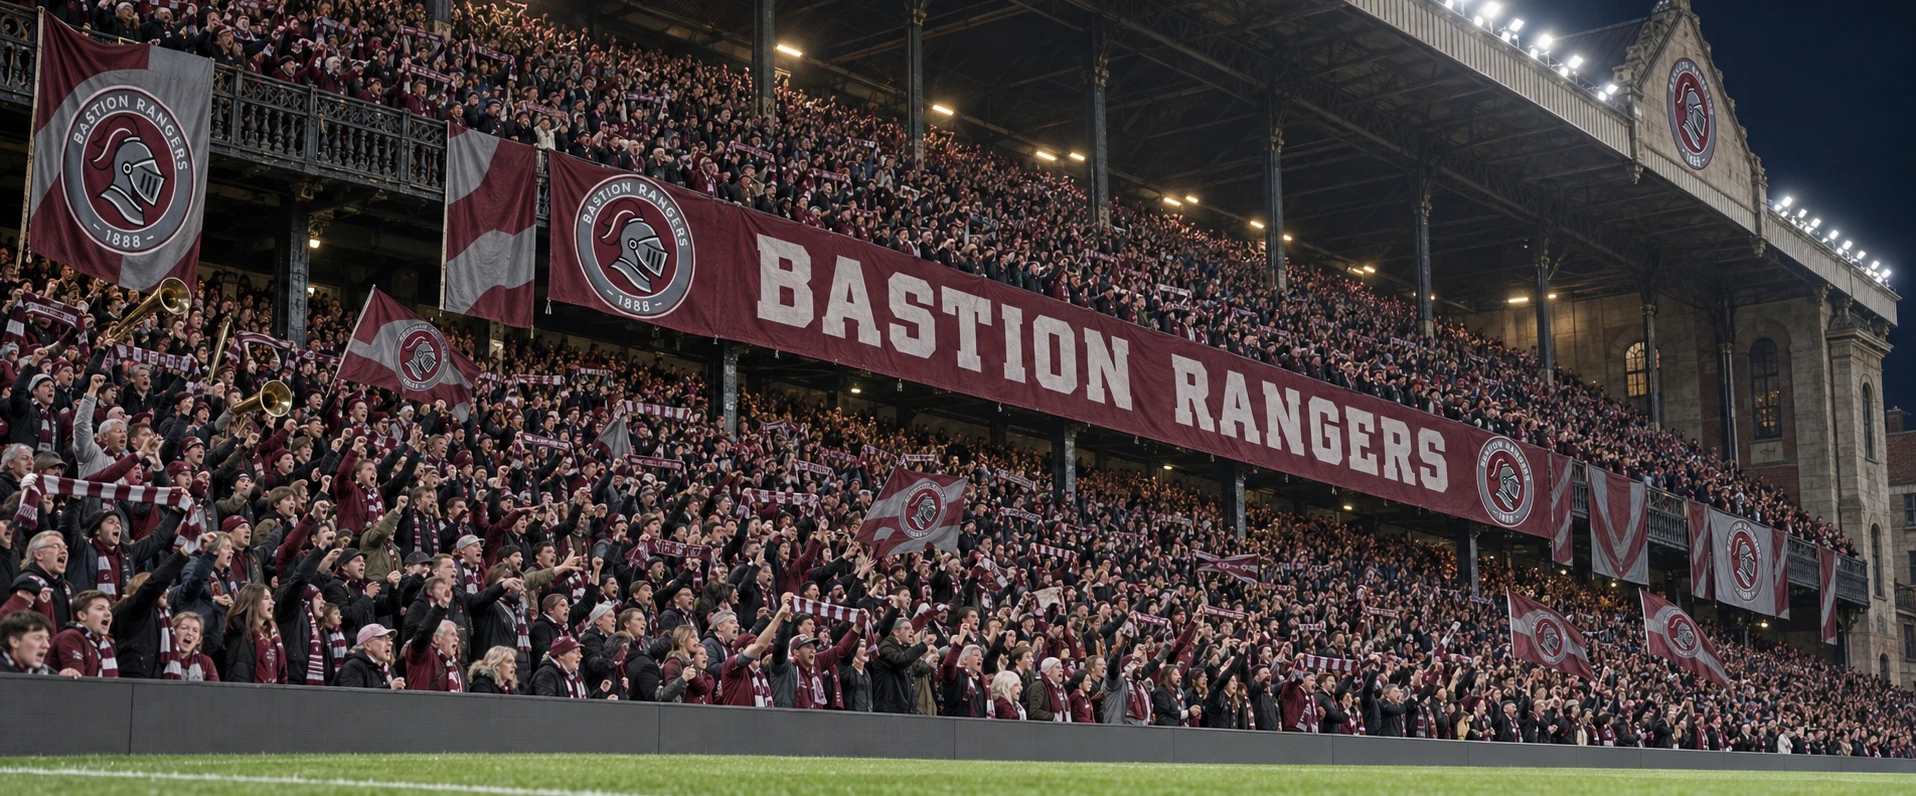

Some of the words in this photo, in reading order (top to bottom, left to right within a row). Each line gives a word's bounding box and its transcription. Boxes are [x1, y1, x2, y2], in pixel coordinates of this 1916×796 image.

[73, 95, 129, 144] BASTION
[136, 98, 188, 170] RANGERS
[105, 230, 141, 248] 1888
[582, 182, 631, 225] BASTION
[638, 183, 688, 247] RANGERS
[618, 295, 650, 312] 1888
[757, 233, 1133, 411] BASTION
[1171, 353, 1449, 493] RANGERS
